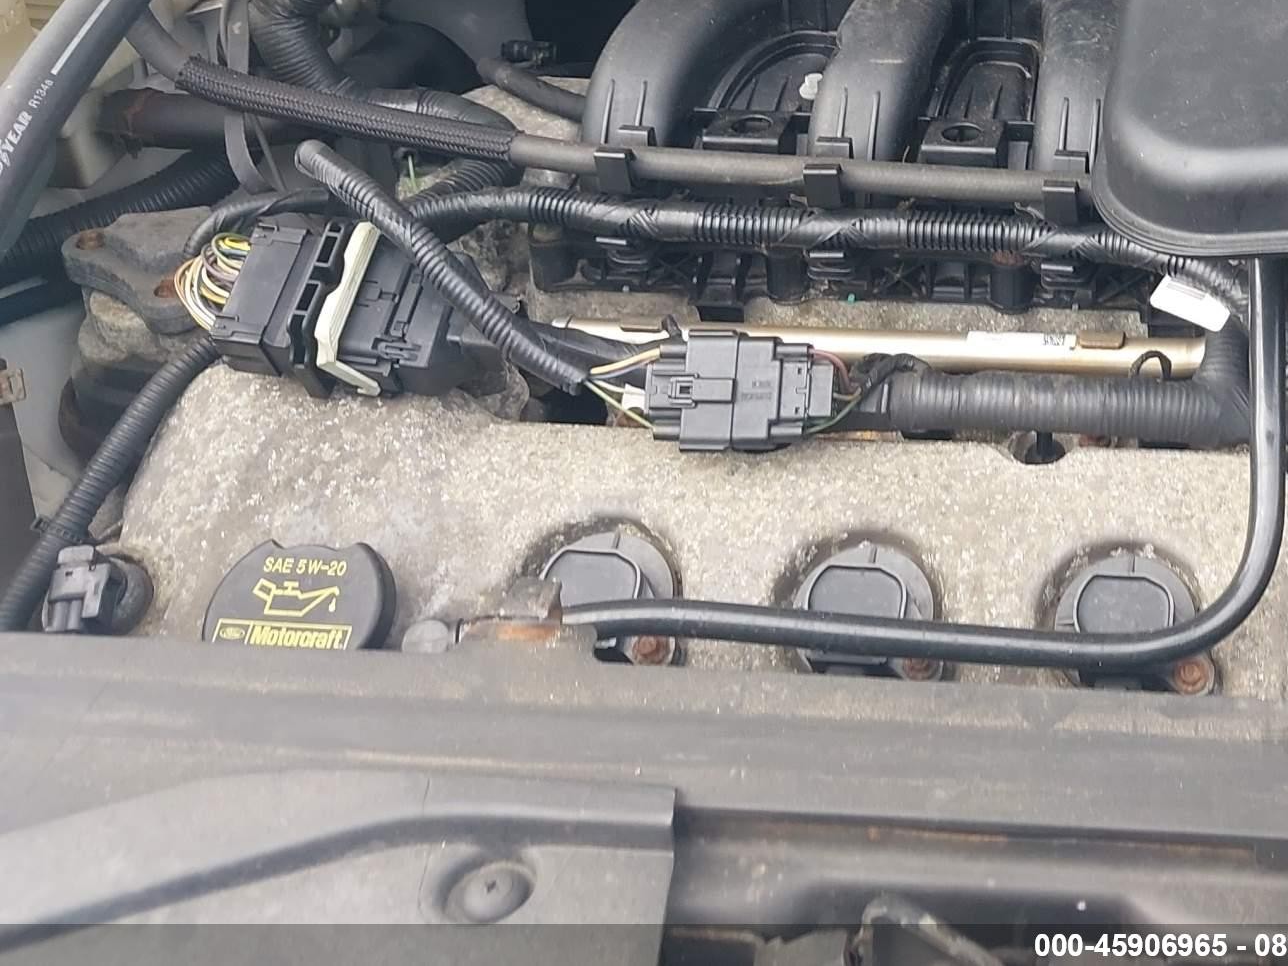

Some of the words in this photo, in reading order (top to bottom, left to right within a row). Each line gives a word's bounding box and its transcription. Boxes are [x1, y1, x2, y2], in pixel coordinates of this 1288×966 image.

[263, 556, 295, 574] SAE
[296, 559, 347, 576] 5W-20
[250, 624, 344, 650] Motorcraft
